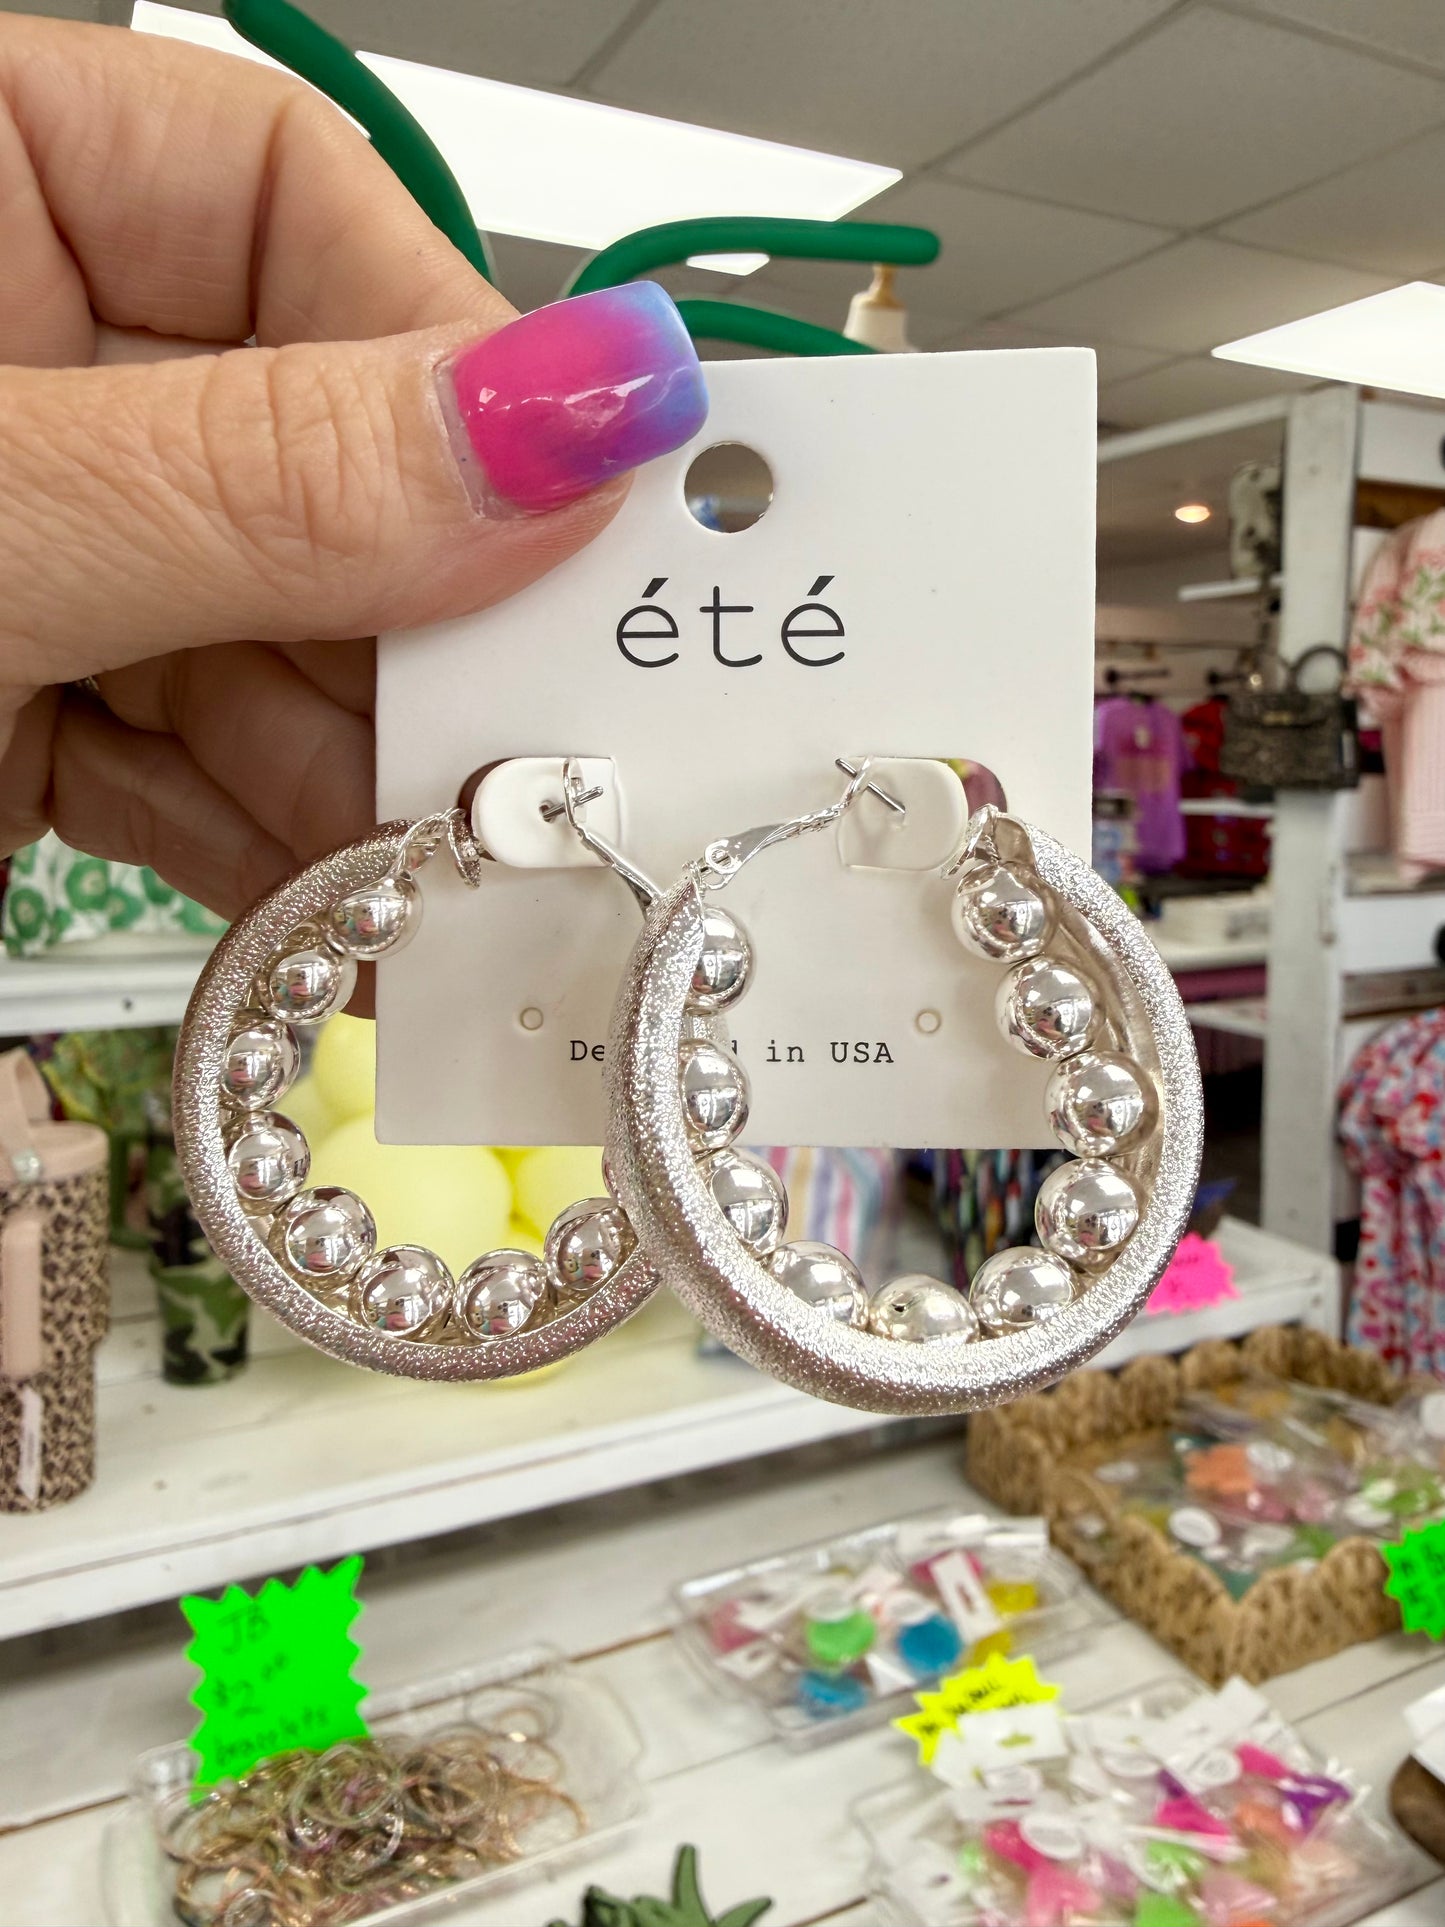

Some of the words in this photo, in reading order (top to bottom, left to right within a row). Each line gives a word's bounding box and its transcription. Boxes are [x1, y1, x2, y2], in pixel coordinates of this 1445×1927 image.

[616, 575, 846, 669] été
[766, 1039, 805, 1063] in
[829, 1041, 895, 1064] USA
